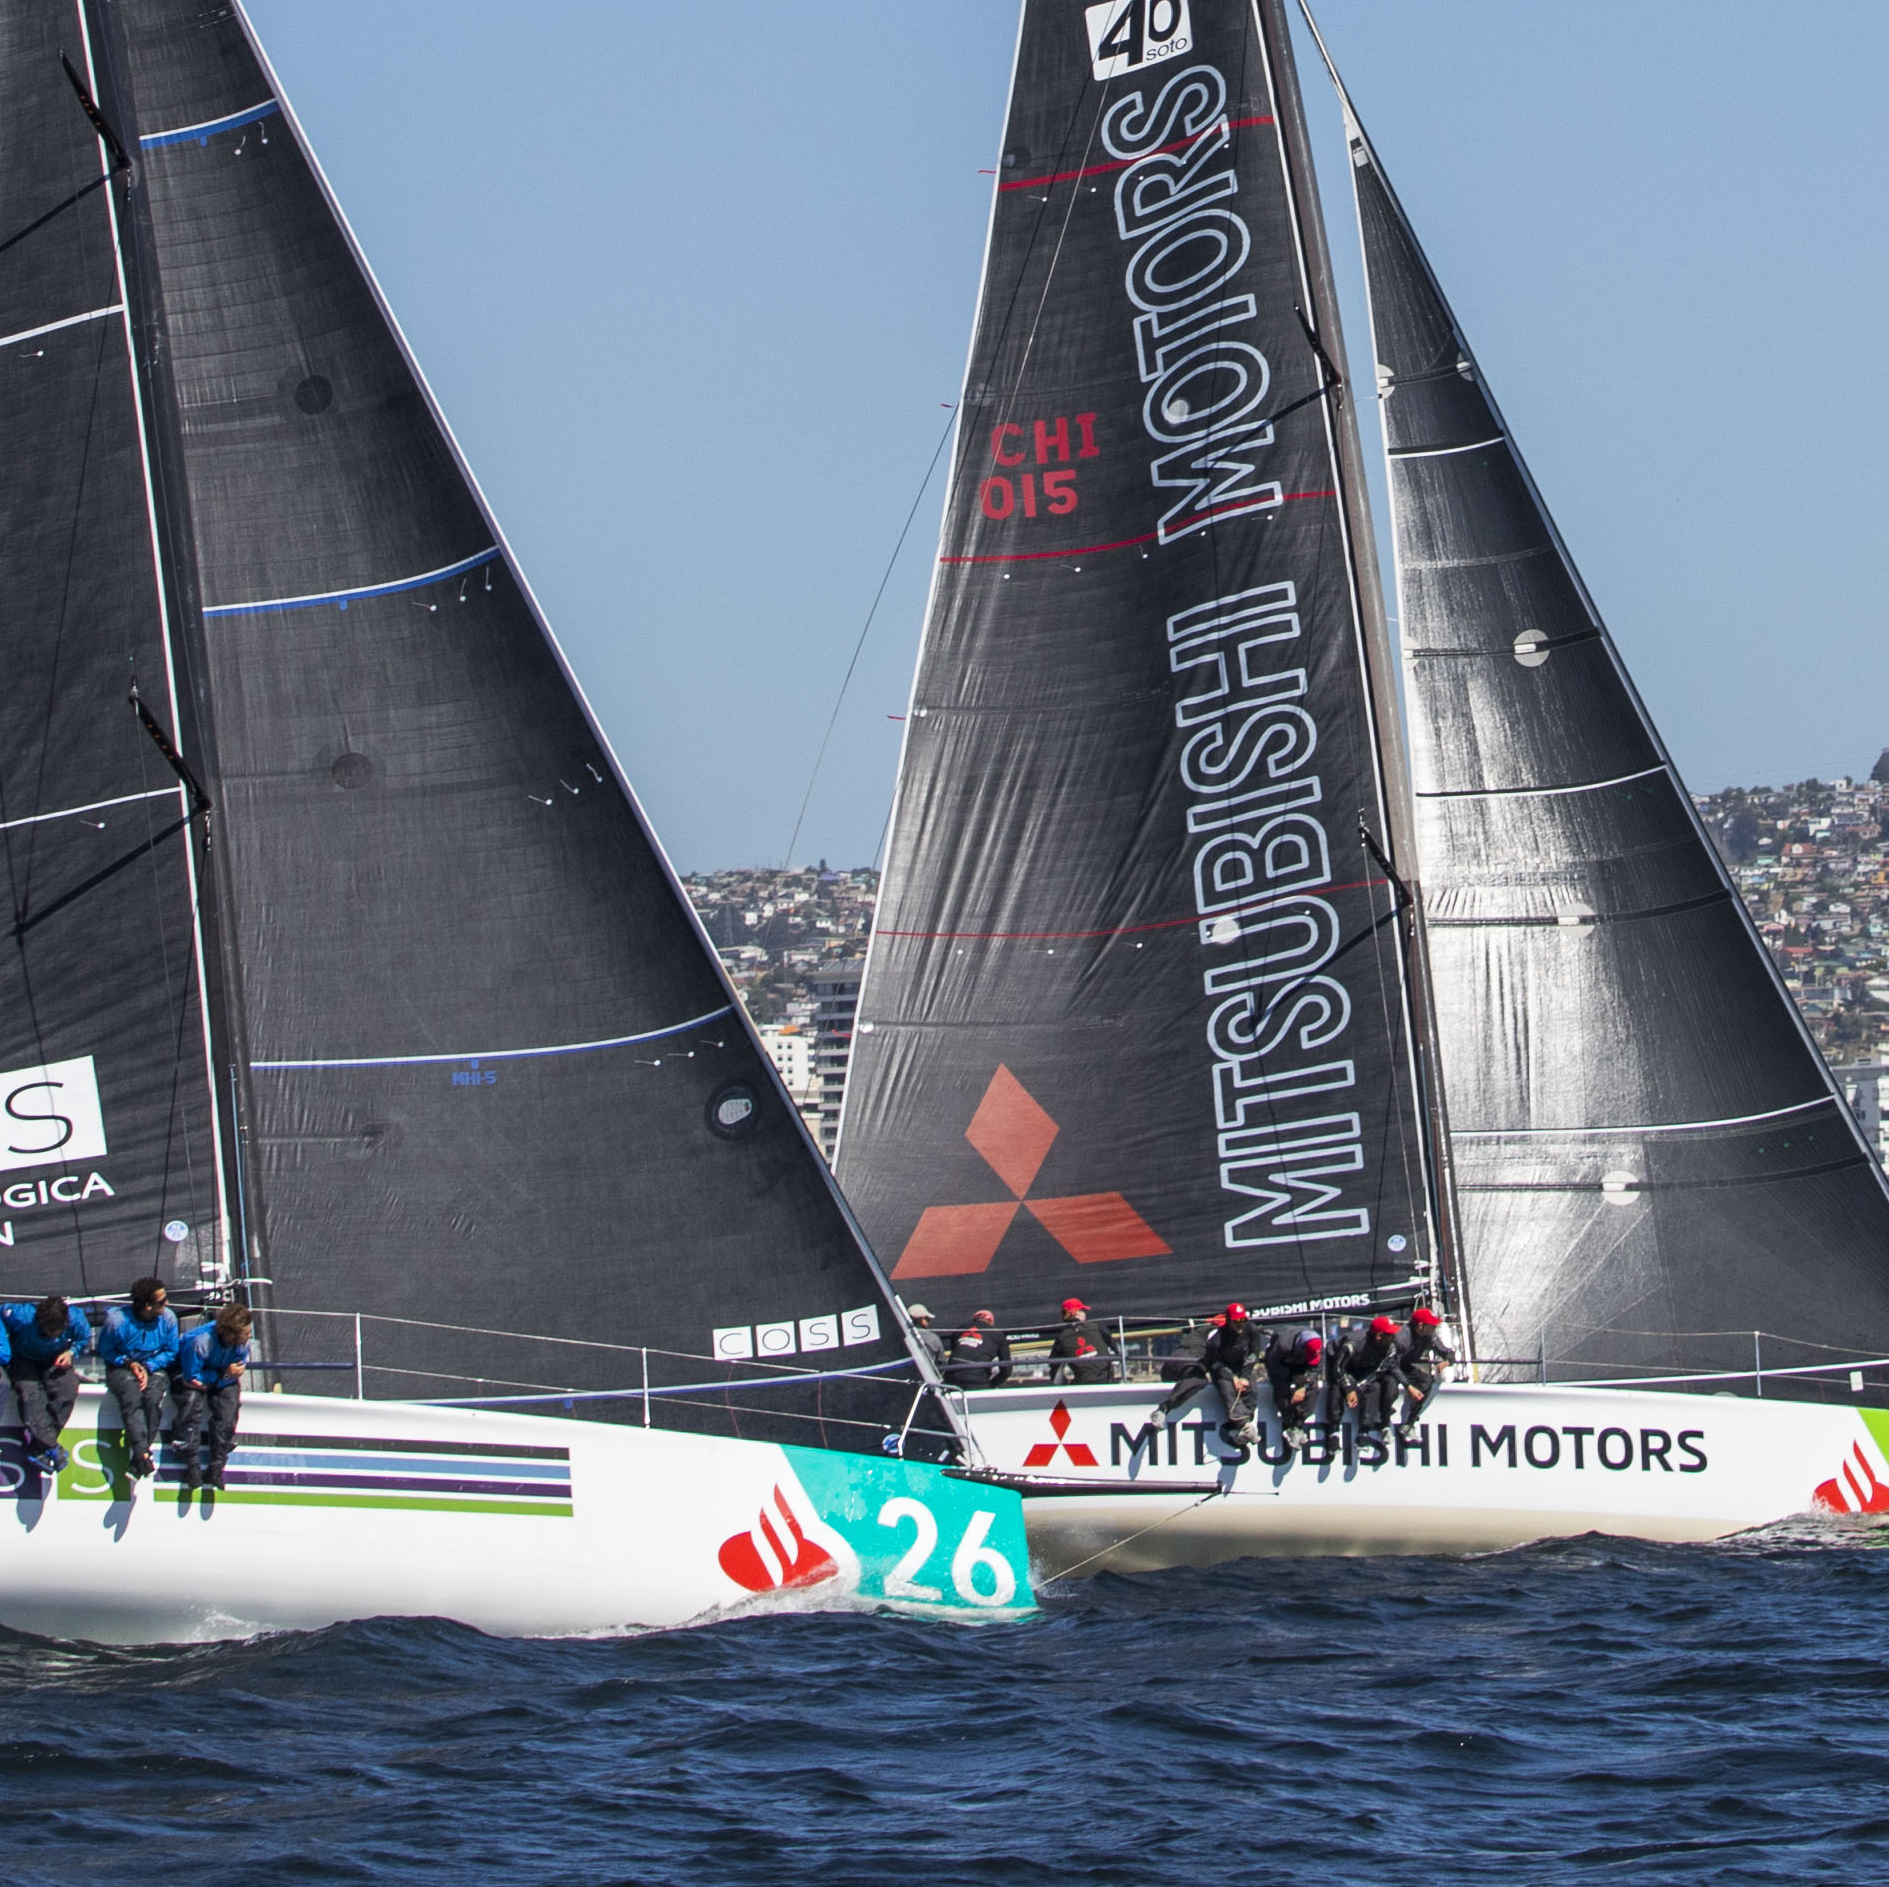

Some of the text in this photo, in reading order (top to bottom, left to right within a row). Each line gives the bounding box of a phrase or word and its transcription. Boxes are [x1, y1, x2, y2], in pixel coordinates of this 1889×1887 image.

[1146, 38, 1187, 61] soto
[991, 412, 1100, 467] CHI
[980, 469, 1078, 520] 015
[1102, 65, 1370, 1248] MITSUBISHI MOTORS
[1309, 1294, 1370, 1311] MOTORS
[719, 1313, 871, 1355] COSS
[1471, 1424, 1708, 1473] MOTORS
[877, 1497, 1016, 1607] 26
